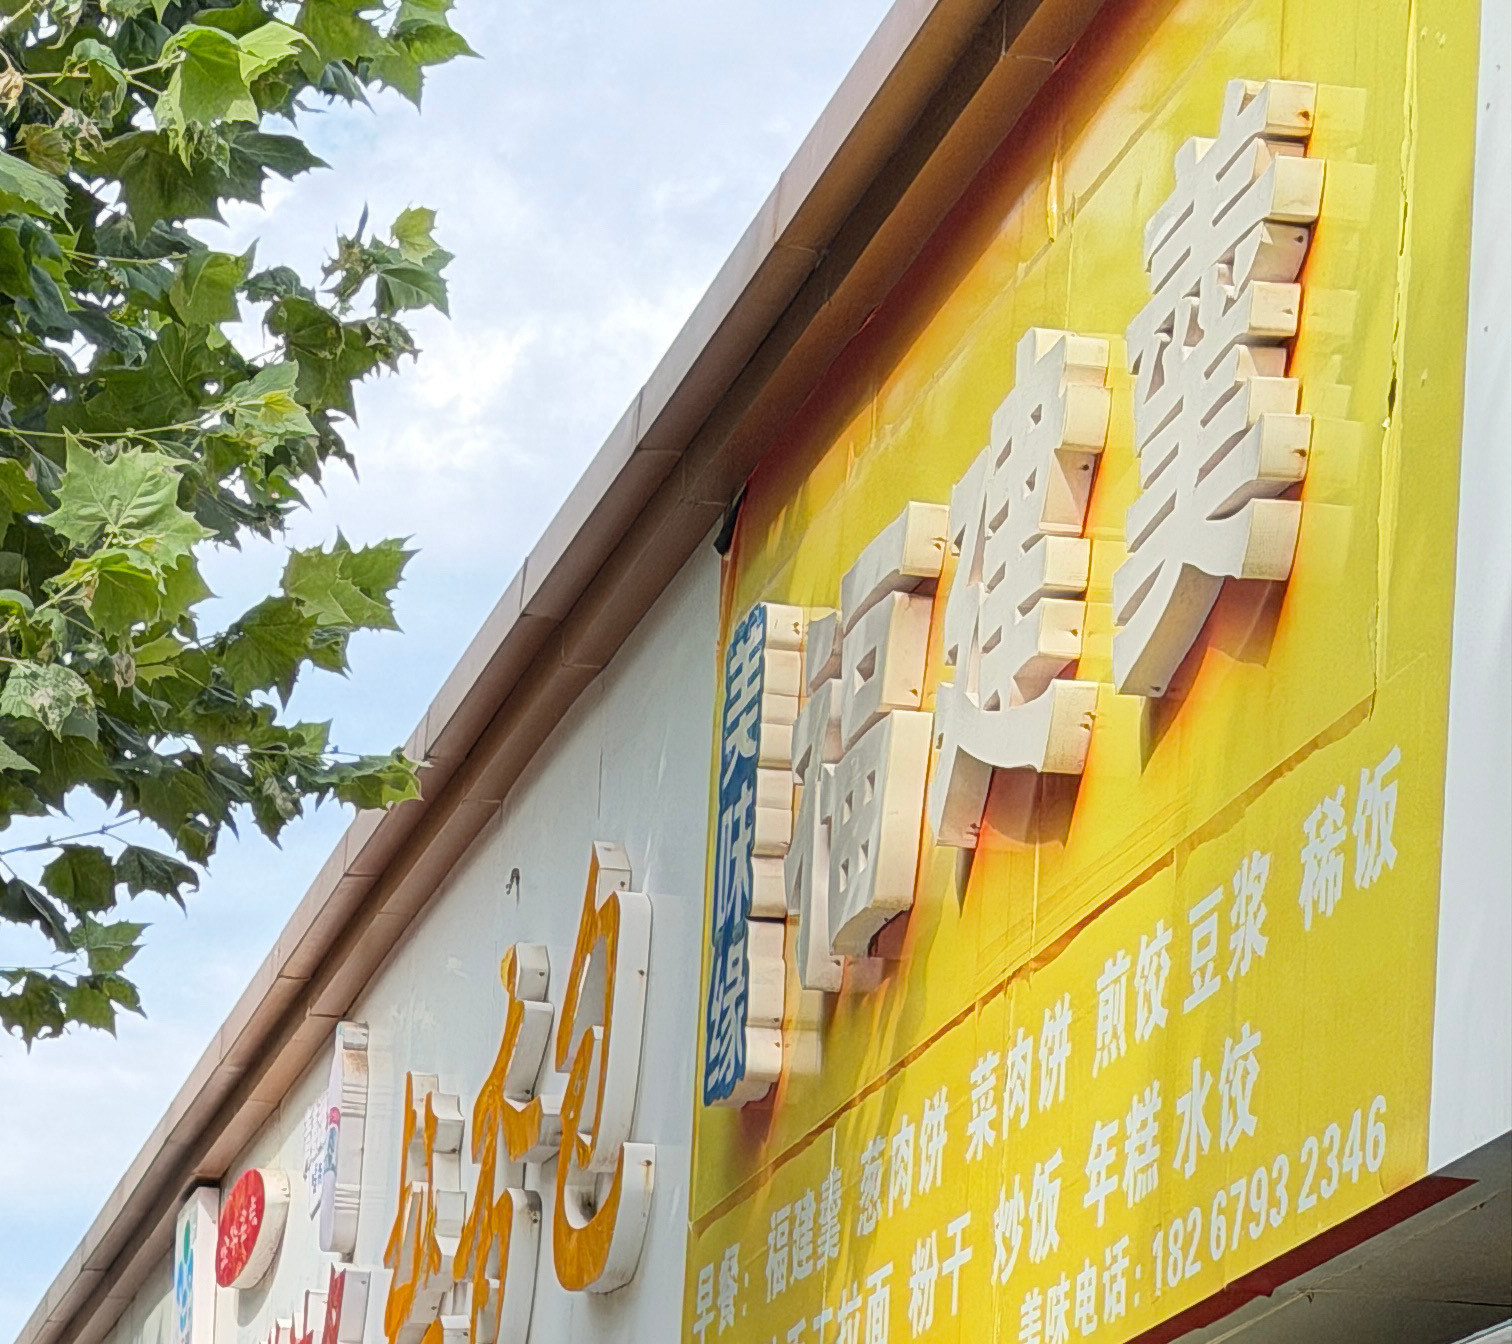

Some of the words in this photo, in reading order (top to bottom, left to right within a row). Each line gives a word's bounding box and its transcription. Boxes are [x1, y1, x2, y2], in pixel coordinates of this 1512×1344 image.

[786, 80, 1324, 992] 福建羹
[708, 616, 764, 1093] 美味缘
[766, 1168, 842, 1306] 福建羹
[966, 992, 1073, 1164] 菜肉饼
[1184, 849, 1271, 1014] 豆浆
[1298, 746, 1400, 931] 稀饭
[909, 1212, 973, 1341] 粉干
[992, 1150, 1061, 1286] 炒饭
[1085, 1078, 1161, 1232] 年糕
[1174, 1021, 1262, 1180] 水饺
[1151, 1215, 1203, 1300] 182
[1210, 1152, 1288, 1256] 6793
[1296, 1094, 1388, 1218] 2346
